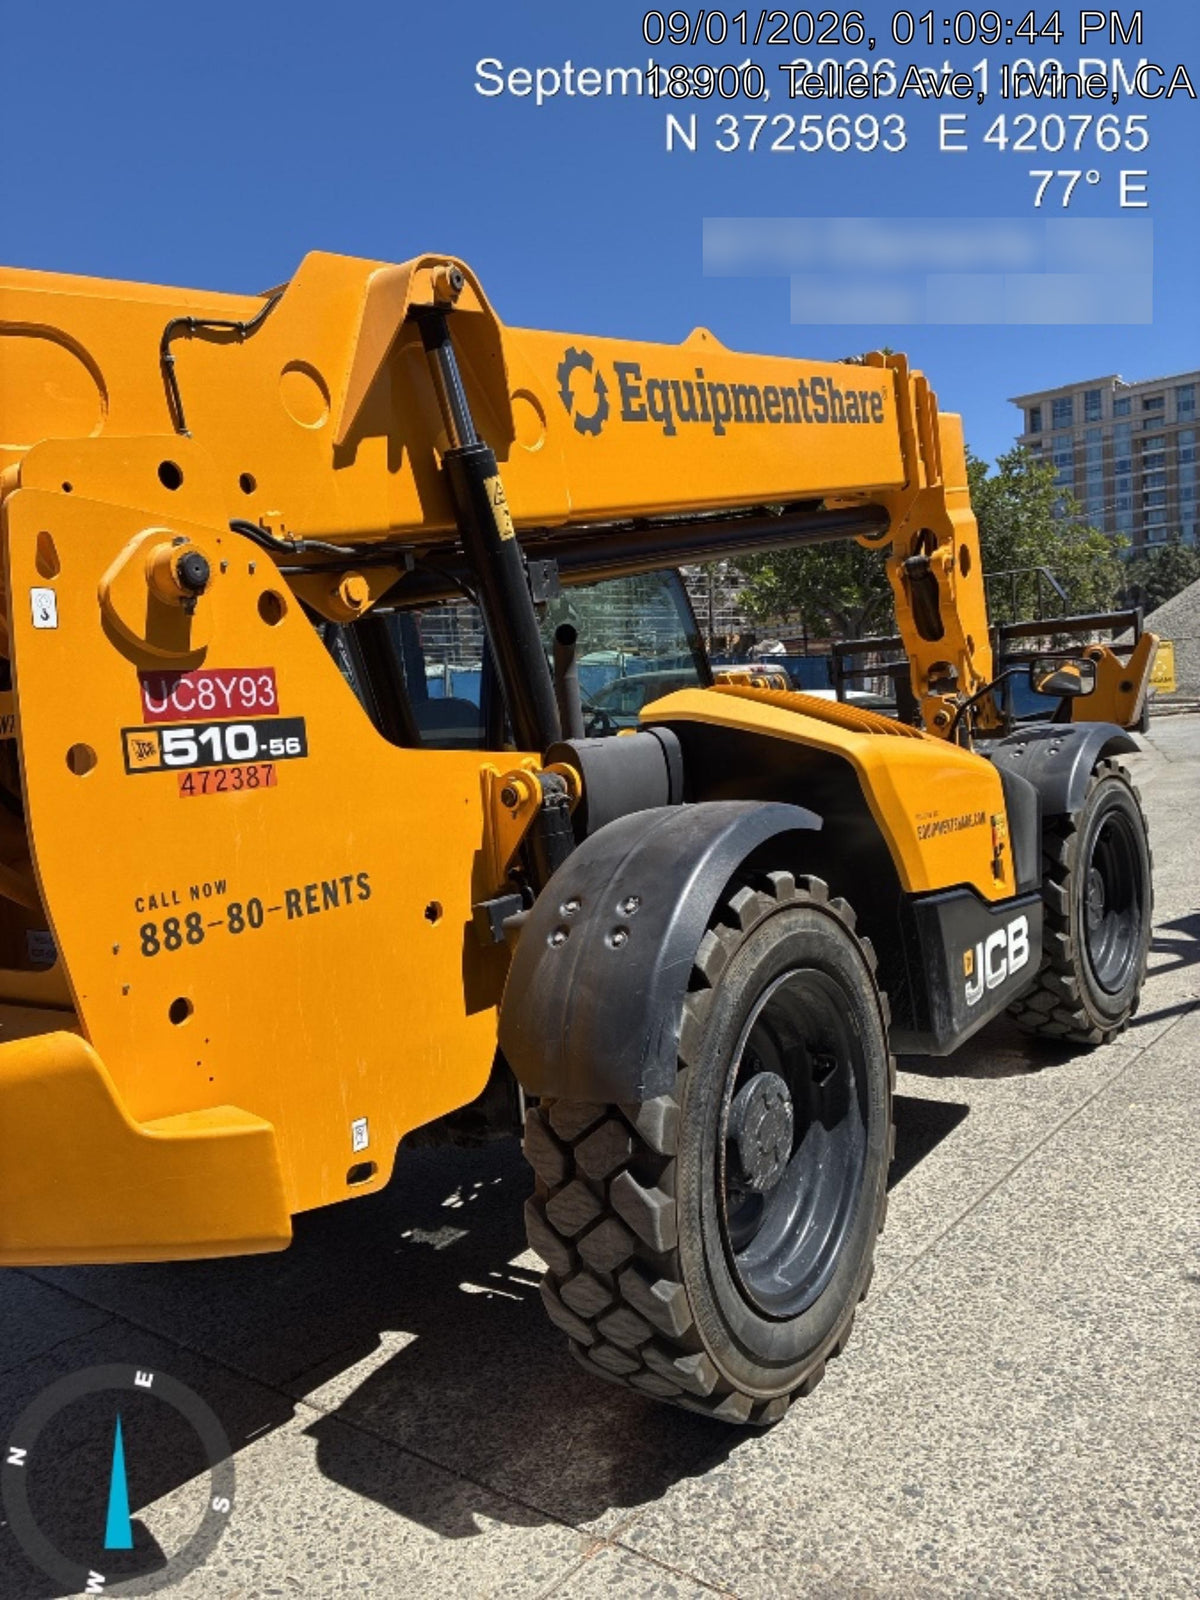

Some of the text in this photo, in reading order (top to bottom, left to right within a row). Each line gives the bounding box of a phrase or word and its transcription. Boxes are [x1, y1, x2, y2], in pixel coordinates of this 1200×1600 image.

[613, 361, 884, 436] EquipmentShare
[143, 675, 276, 714] UC8Y93
[162, 724, 301, 766] 510-56
[181, 764, 273, 796] 472387
[135, 879, 227, 913] CALL NOW
[140, 872, 371, 957] 888-80-RENTS
[965, 914, 1029, 1006] JCB
